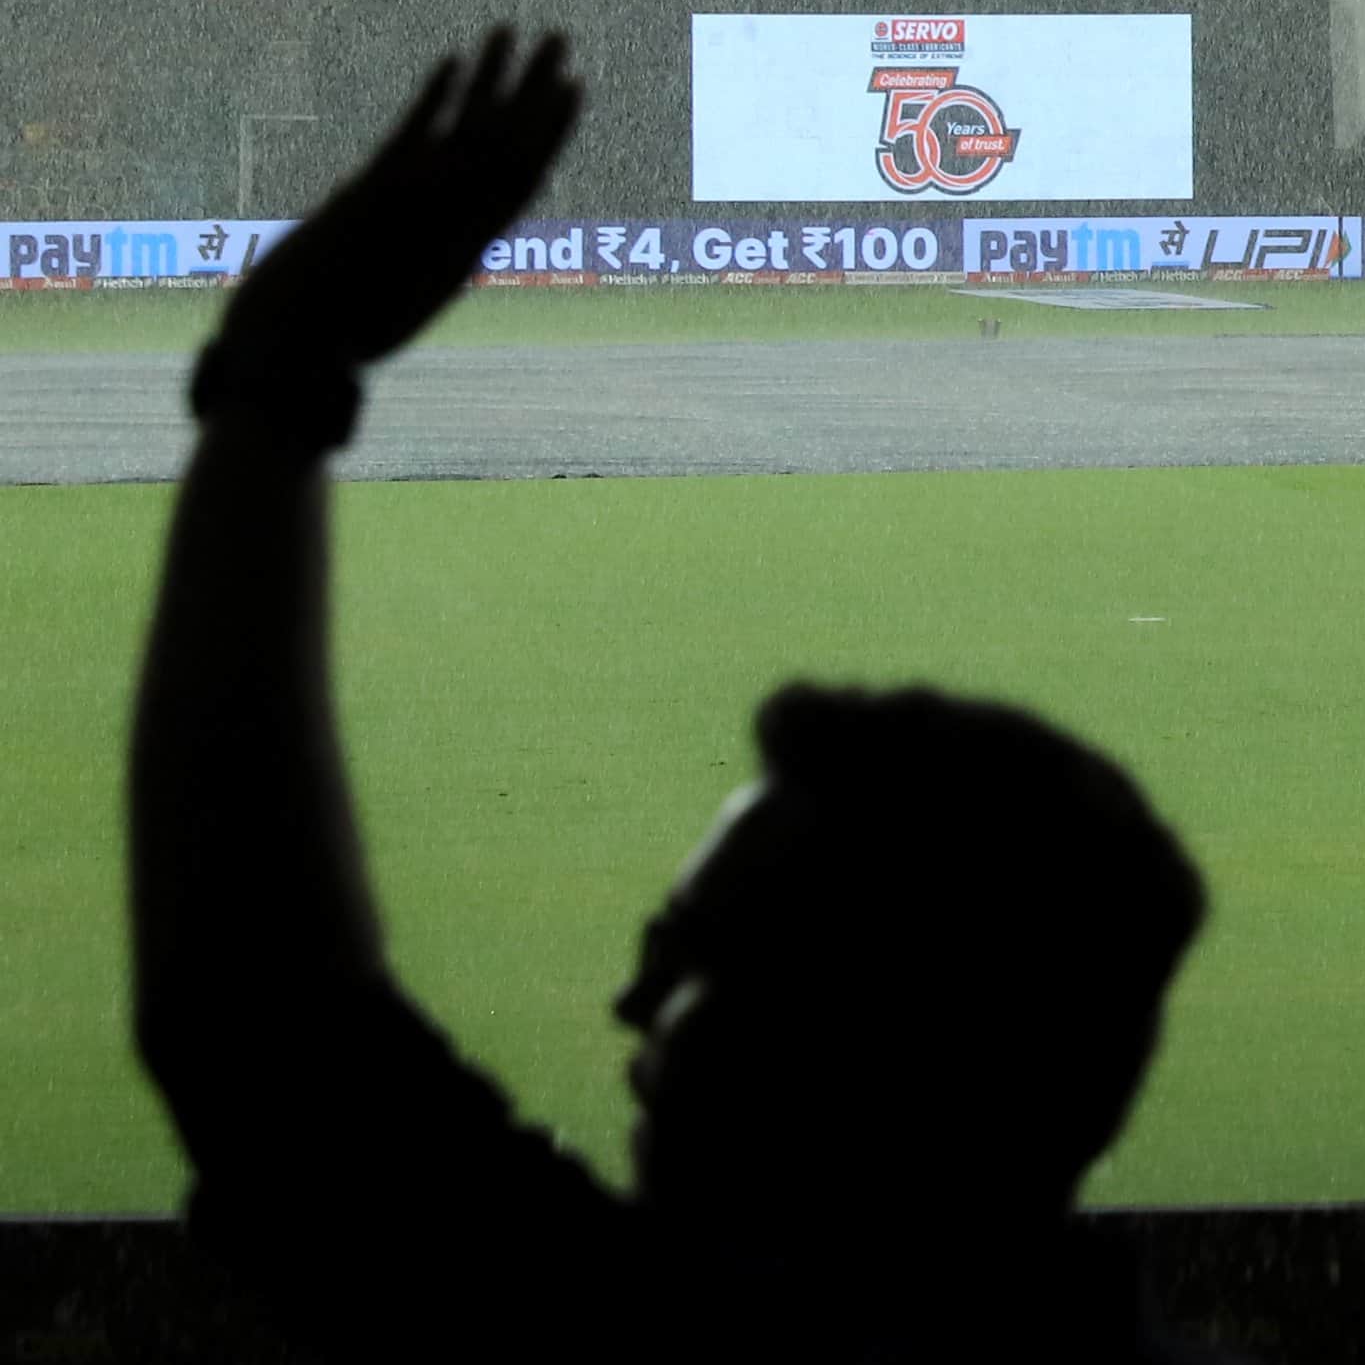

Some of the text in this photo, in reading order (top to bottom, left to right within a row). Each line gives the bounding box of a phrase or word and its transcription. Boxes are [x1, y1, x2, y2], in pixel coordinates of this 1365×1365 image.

[893, 21, 959, 41] SERVO
[880, 72, 948, 89] Celebrating
[878, 84, 1003, 190] 50
[946, 120, 986, 136] Years
[960, 138, 972, 151] of
[196, 225, 228, 262] से
[1158, 220, 1190, 258] से
[481, 226, 938, 275] end ₹4, Get ₹100
[724, 272, 754, 284] ACC
[786, 272, 816, 284] ACC
